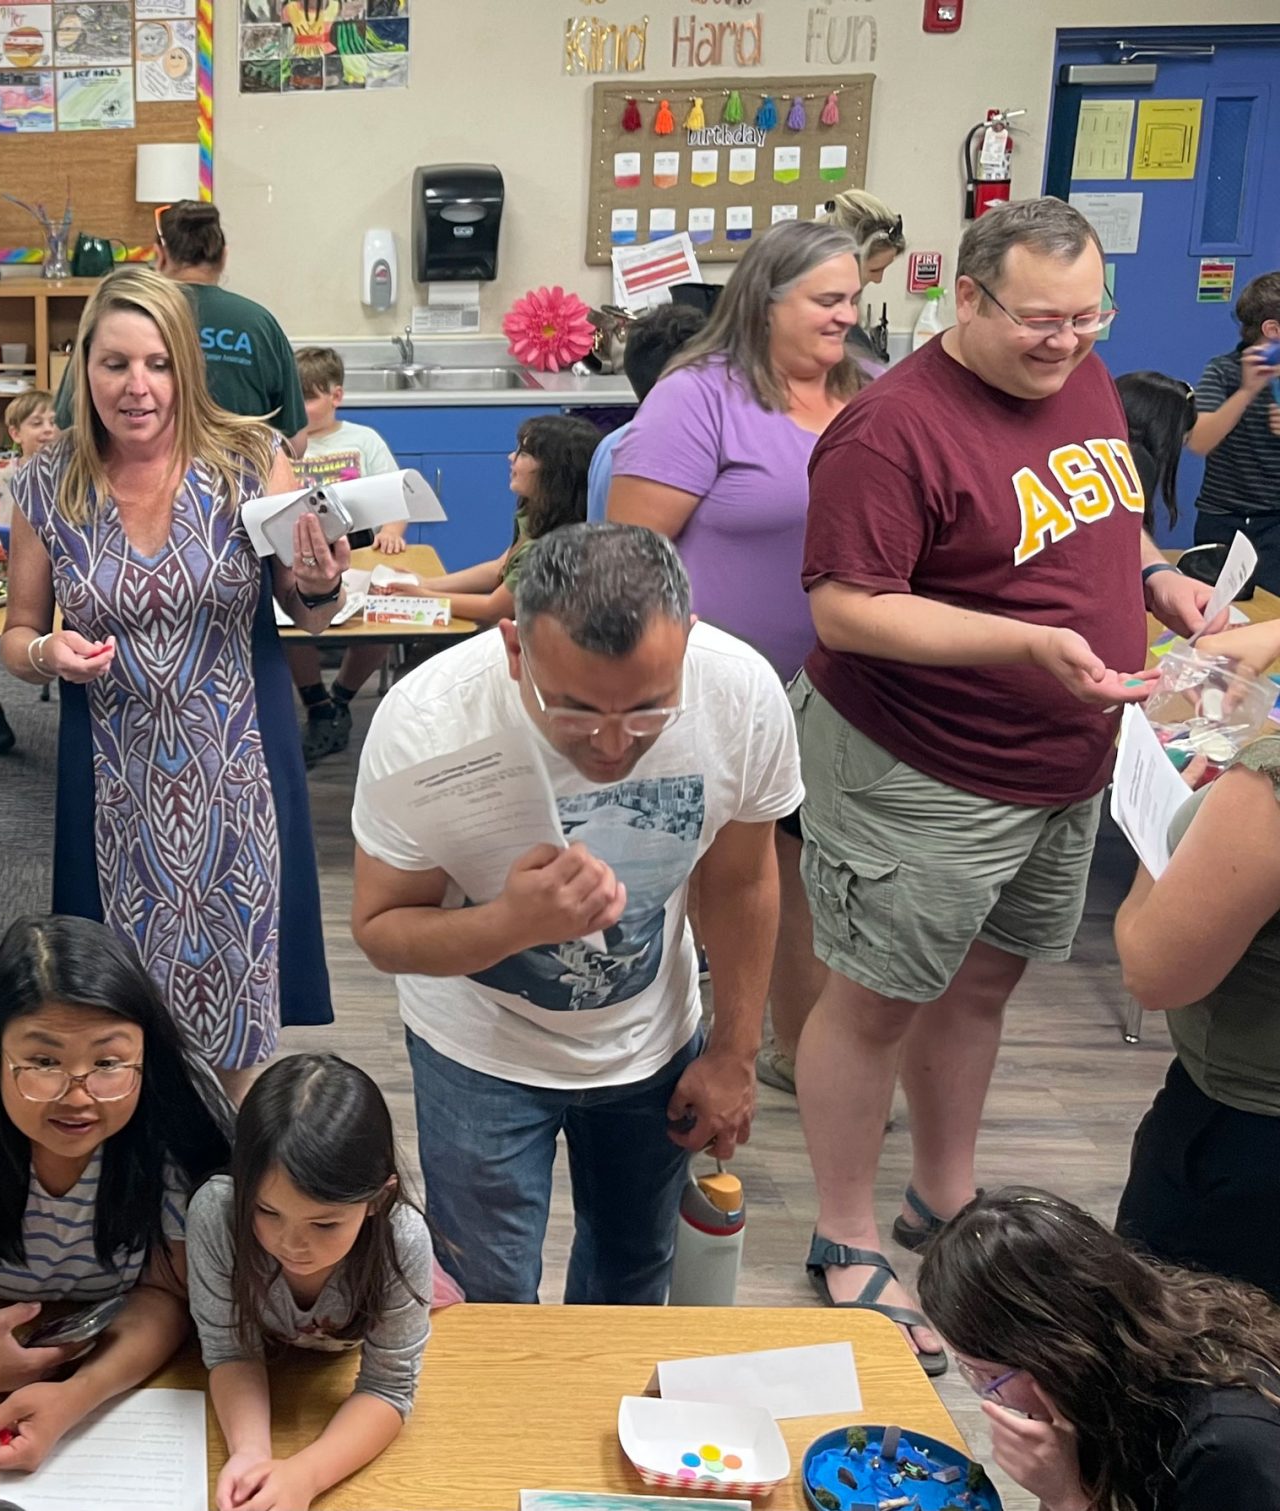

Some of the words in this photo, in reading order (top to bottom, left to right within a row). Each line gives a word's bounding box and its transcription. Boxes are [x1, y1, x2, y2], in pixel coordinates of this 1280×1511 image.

[564, 15, 648, 74] Kind
[672, 12, 764, 67] Hard
[805, 8, 877, 65] Fun
[63, 68, 91, 79] BLACK
[687, 123, 767, 147] birthday
[916, 254, 938, 265] FIRE
[1011, 438, 1145, 567] ASU
